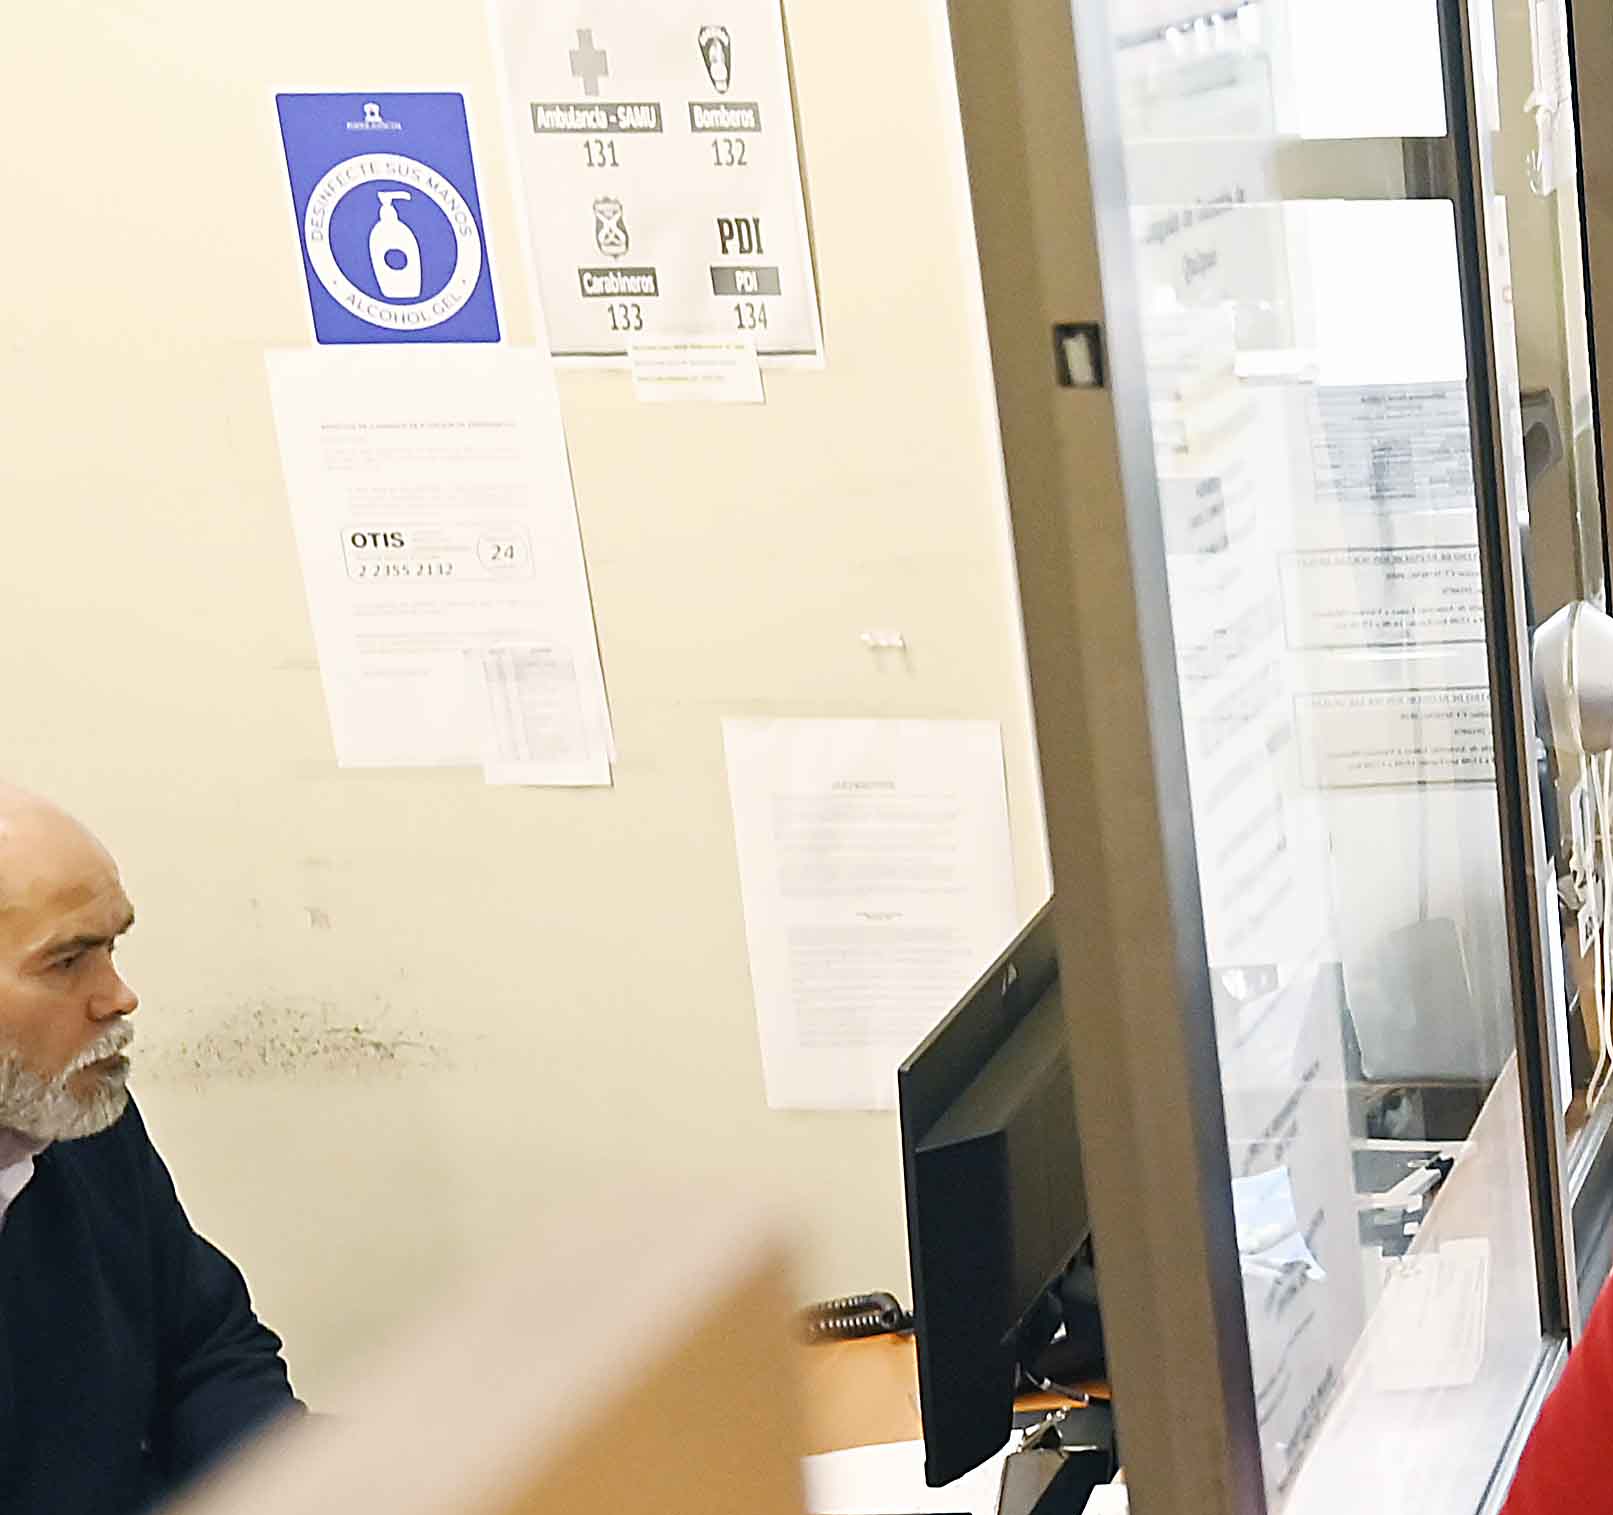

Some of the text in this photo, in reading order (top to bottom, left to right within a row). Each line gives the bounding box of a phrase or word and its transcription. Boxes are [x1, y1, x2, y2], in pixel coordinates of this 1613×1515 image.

[536, 106, 608, 130] Ambulancia
[617, 104, 657, 129] SAMU
[693, 105, 756, 129] Bomberos
[583, 139, 620, 167] 131
[711, 138, 748, 167] 132
[386, 162, 421, 181] SUS
[426, 177, 473, 237] MANOS
[716, 217, 765, 254] PDI
[582, 272, 655, 294] Carabineros
[734, 270, 759, 292] PDI
[346, 291, 463, 325] ALCOHOL GEL
[607, 303, 644, 331] 133
[733, 302, 768, 329] 134
[351, 532, 405, 549] OTIS
[491, 544, 514, 560] 24
